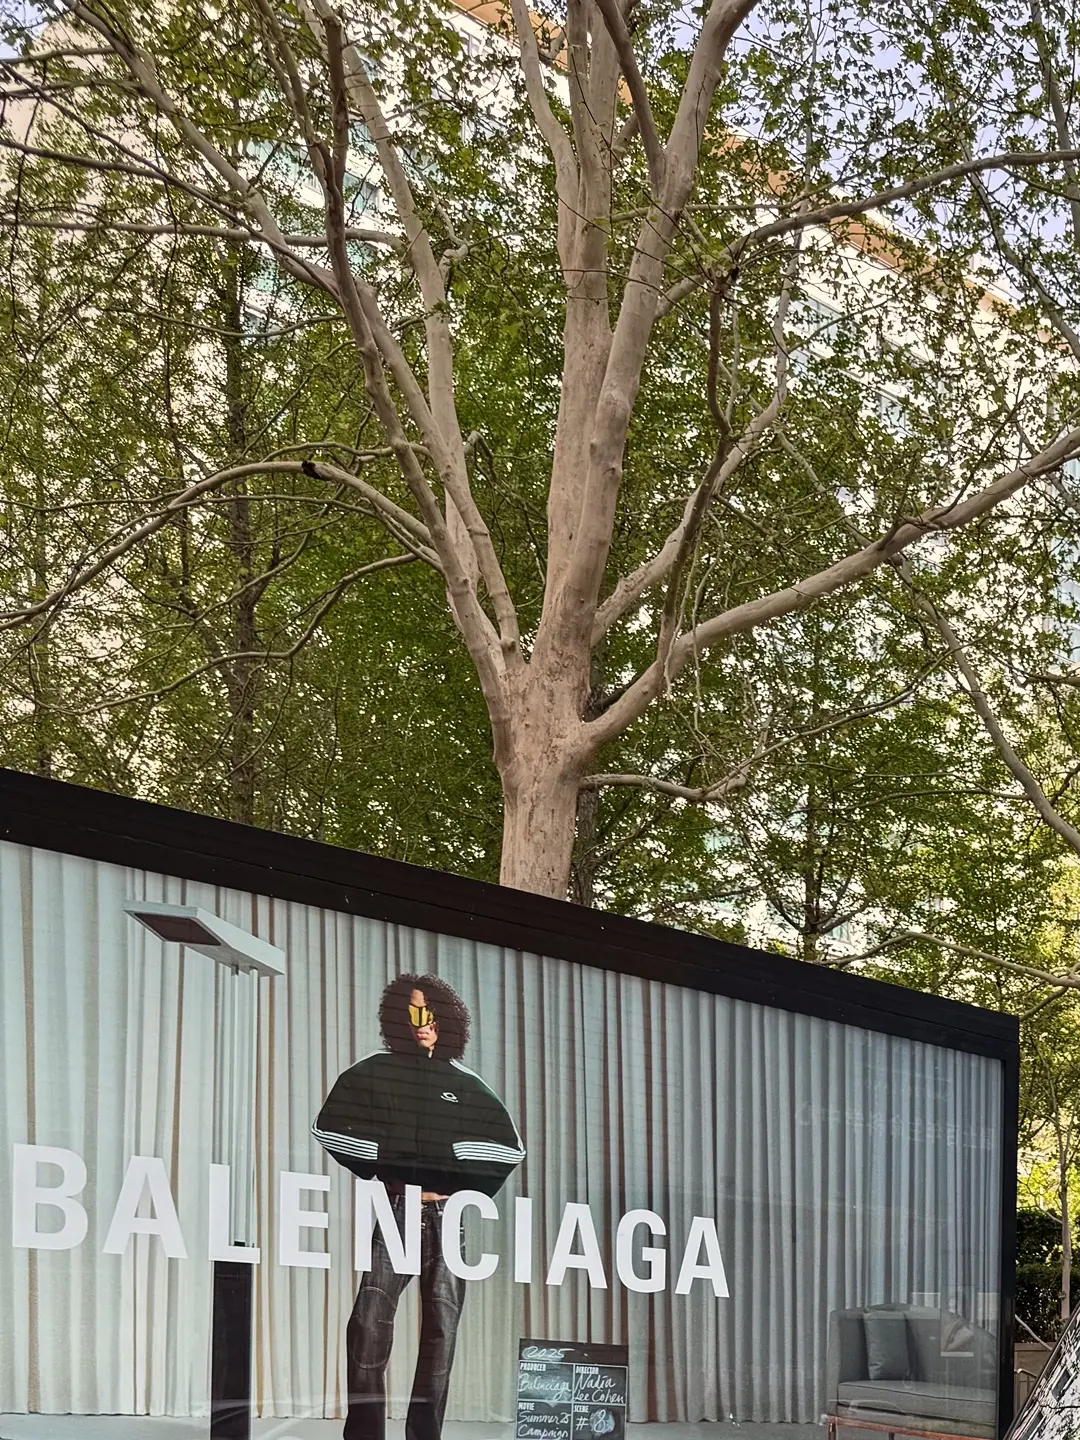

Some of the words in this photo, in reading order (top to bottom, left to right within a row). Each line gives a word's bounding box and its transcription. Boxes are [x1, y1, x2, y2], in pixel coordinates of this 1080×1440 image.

[12, 1143, 730, 1299] BALENCIAGA
[521, 1346, 575, 1360] 2025
[520, 1362, 547, 1372] PRODUCER
[575, 1365, 600, 1375] DIRECTOR
[518, 1372, 571, 1401] Balenciaga
[573, 1372, 616, 1394] Nadia
[573, 1390, 590, 1401] Lee
[591, 1389, 624, 1404] Cohen
[518, 1402, 535, 1411] MOVIE
[573, 1405, 589, 1413] SCENE
[517, 1411, 559, 1424] Summer
